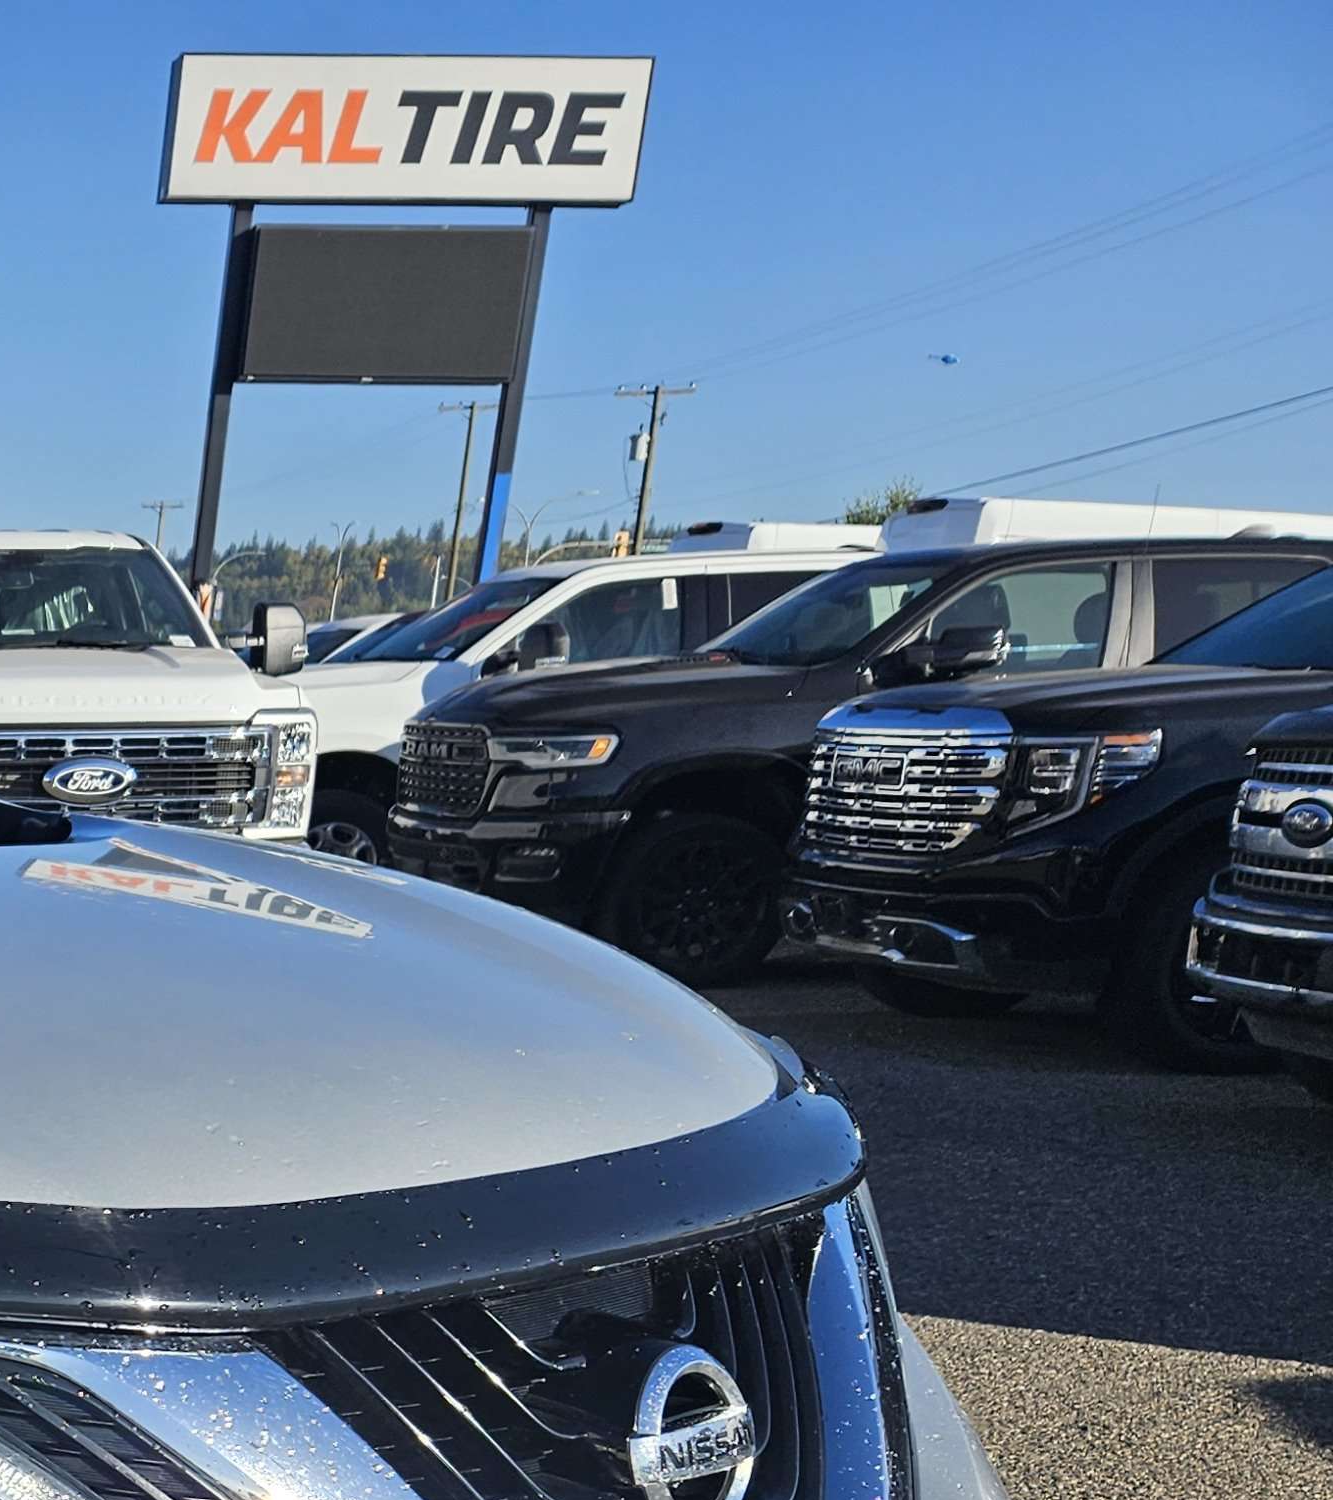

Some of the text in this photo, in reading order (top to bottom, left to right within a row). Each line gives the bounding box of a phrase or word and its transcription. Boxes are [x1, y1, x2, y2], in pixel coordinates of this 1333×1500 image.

[193, 87, 627, 166] KAL TIRE
[402, 740, 448, 758] RAM
[66, 769, 115, 792] Ford
[836, 756, 902, 783] GMC
[659, 1418, 753, 1474] NISSAN
